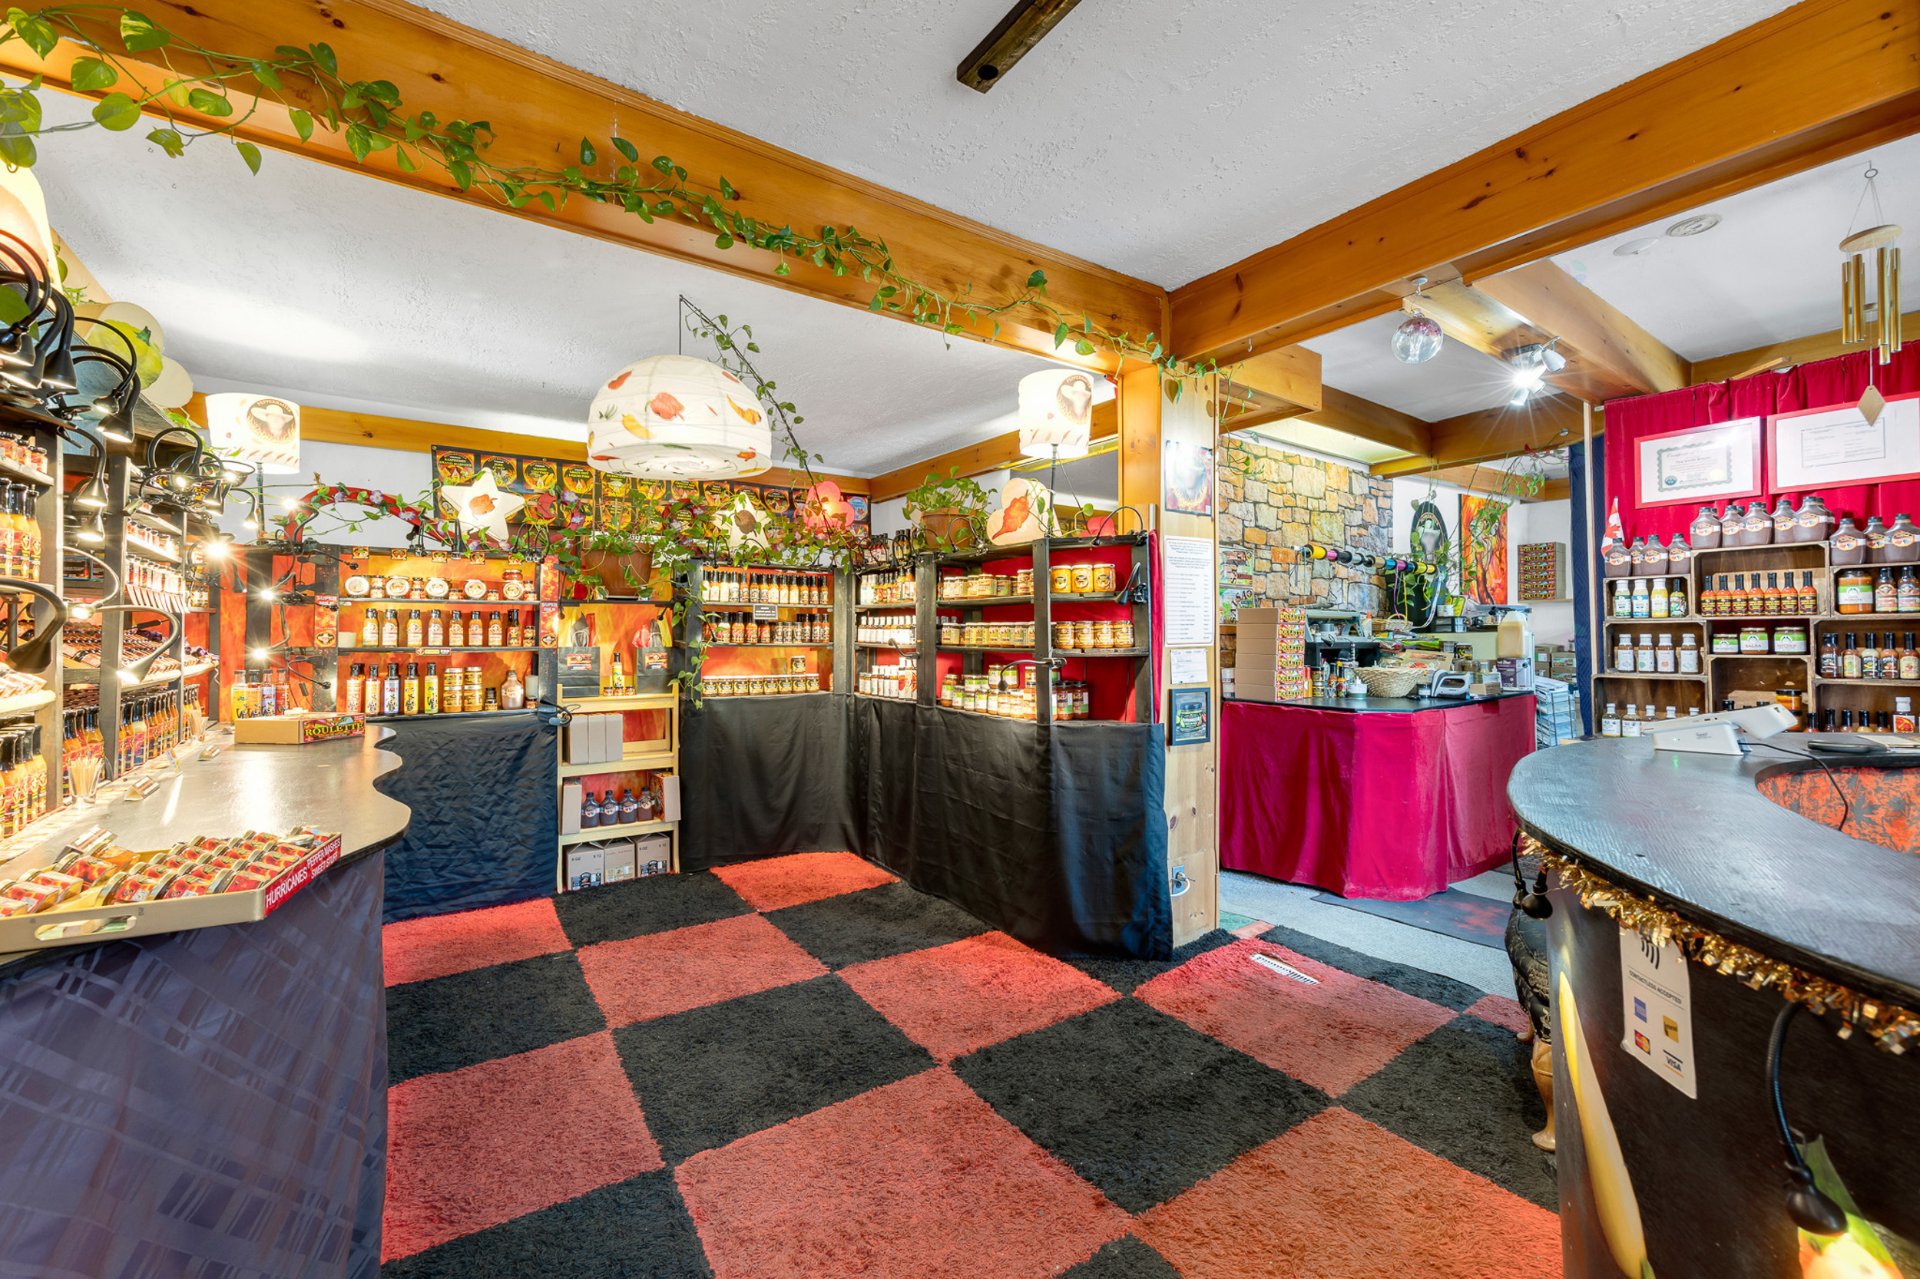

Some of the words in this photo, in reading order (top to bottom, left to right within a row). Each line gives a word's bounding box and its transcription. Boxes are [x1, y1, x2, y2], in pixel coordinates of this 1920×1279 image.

[305, 723, 364, 736] ROULETTE
[306, 850, 325, 868] PEPPER
[265, 866, 309, 908] HURRICANES
[1666, 1056, 1682, 1072] VISA
